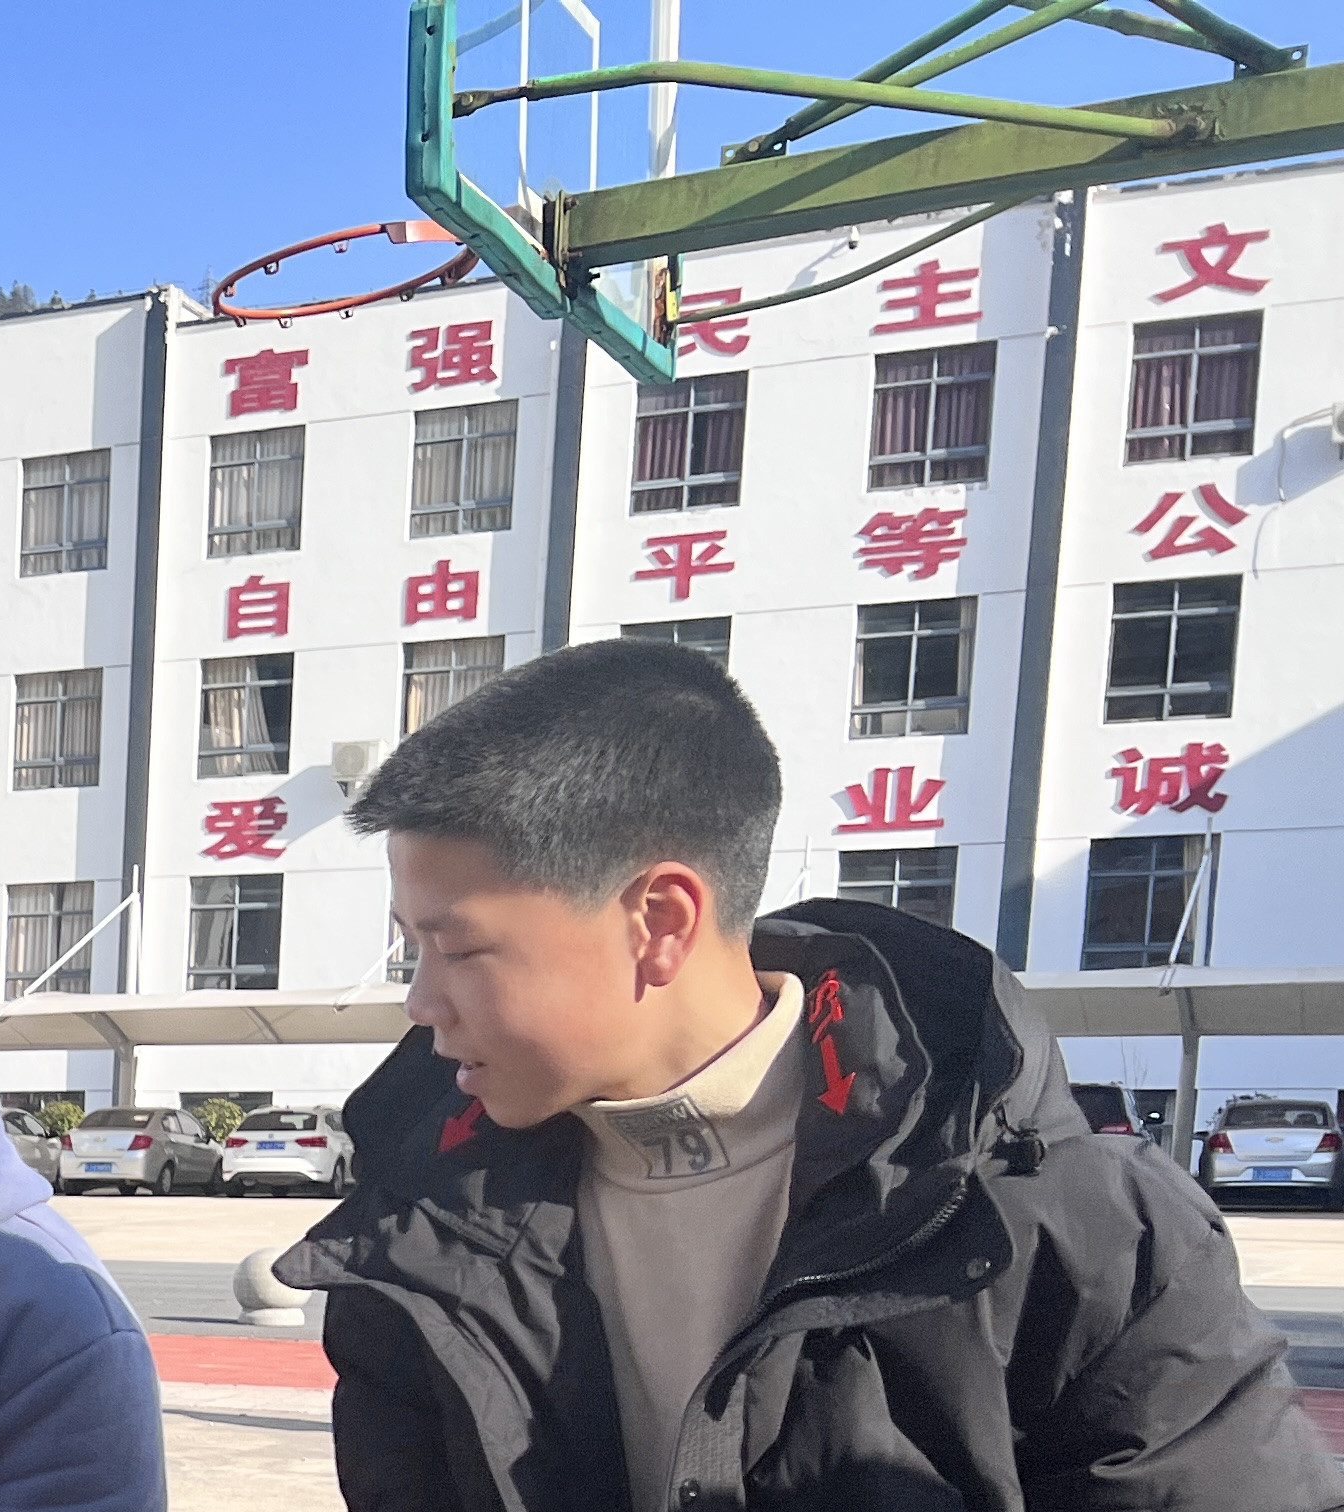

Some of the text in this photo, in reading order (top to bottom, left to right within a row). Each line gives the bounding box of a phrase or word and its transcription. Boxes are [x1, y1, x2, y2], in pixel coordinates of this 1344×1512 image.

[1159, 225, 1268, 302] 文
[1137, 486, 1247, 559] 公
[205, 743, 1230, 860] 爱 业 诚
